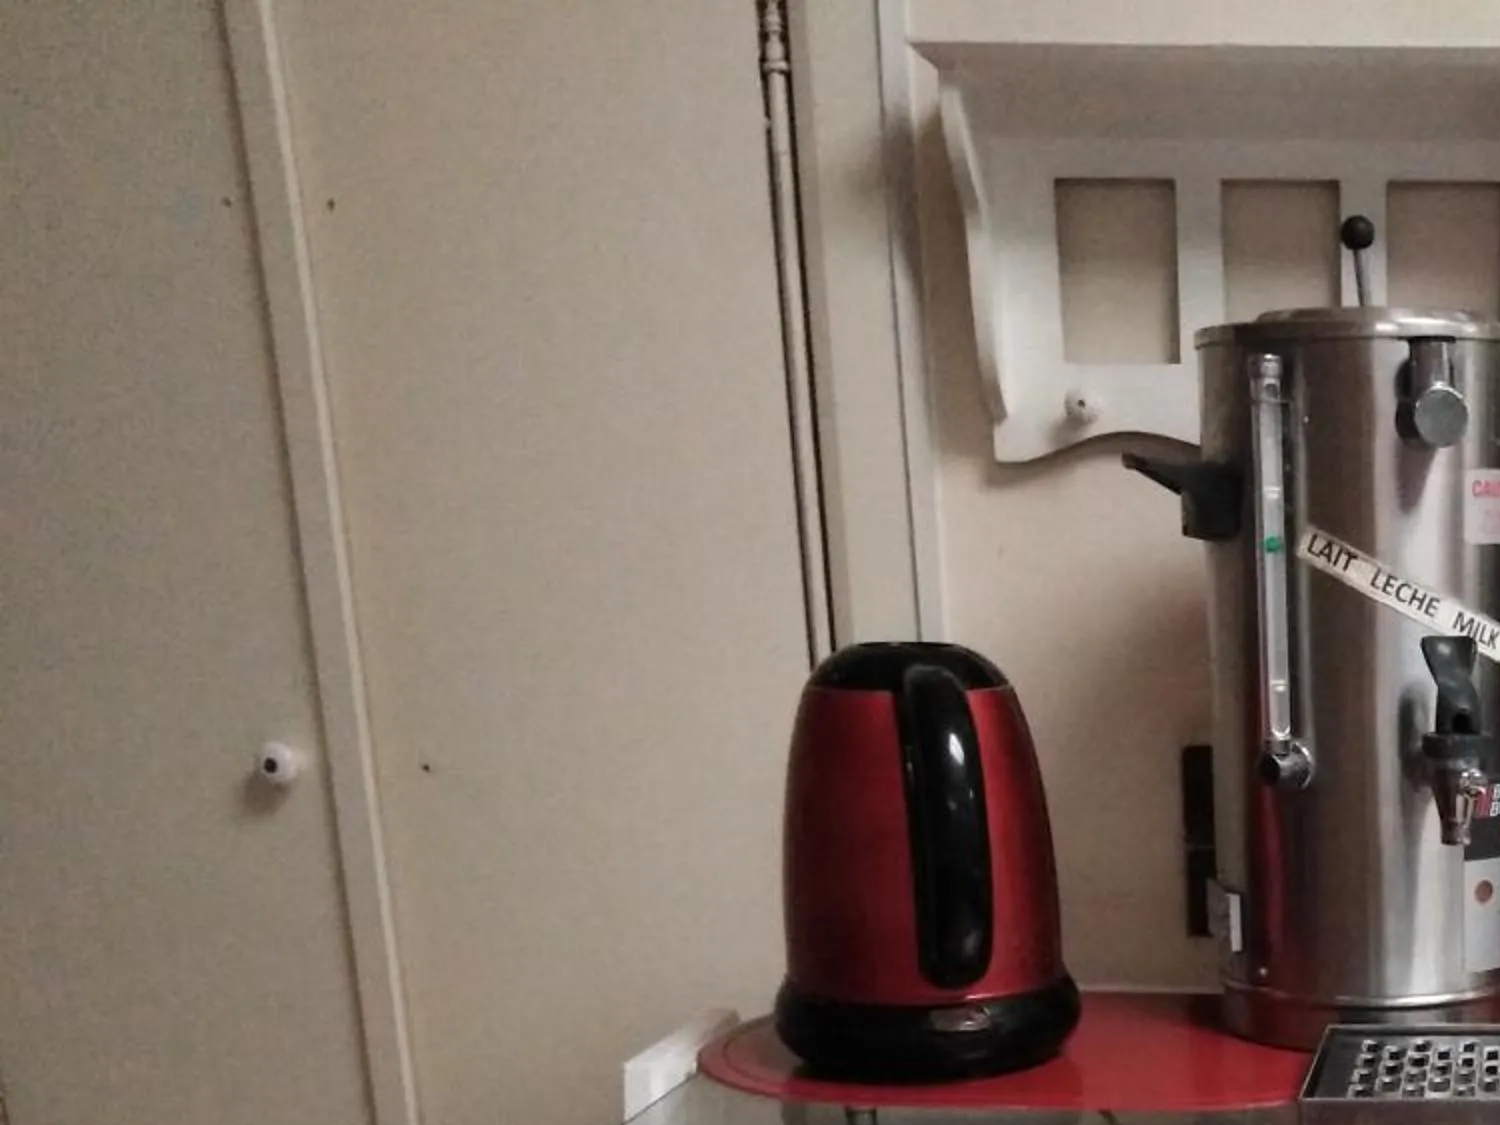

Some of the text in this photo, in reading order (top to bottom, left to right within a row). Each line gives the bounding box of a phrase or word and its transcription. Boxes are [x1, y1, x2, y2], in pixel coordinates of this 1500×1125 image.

[1307, 534, 1358, 572] LAIT
[1370, 567, 1441, 618] LECHE
[1453, 612, 1500, 650] MILK
